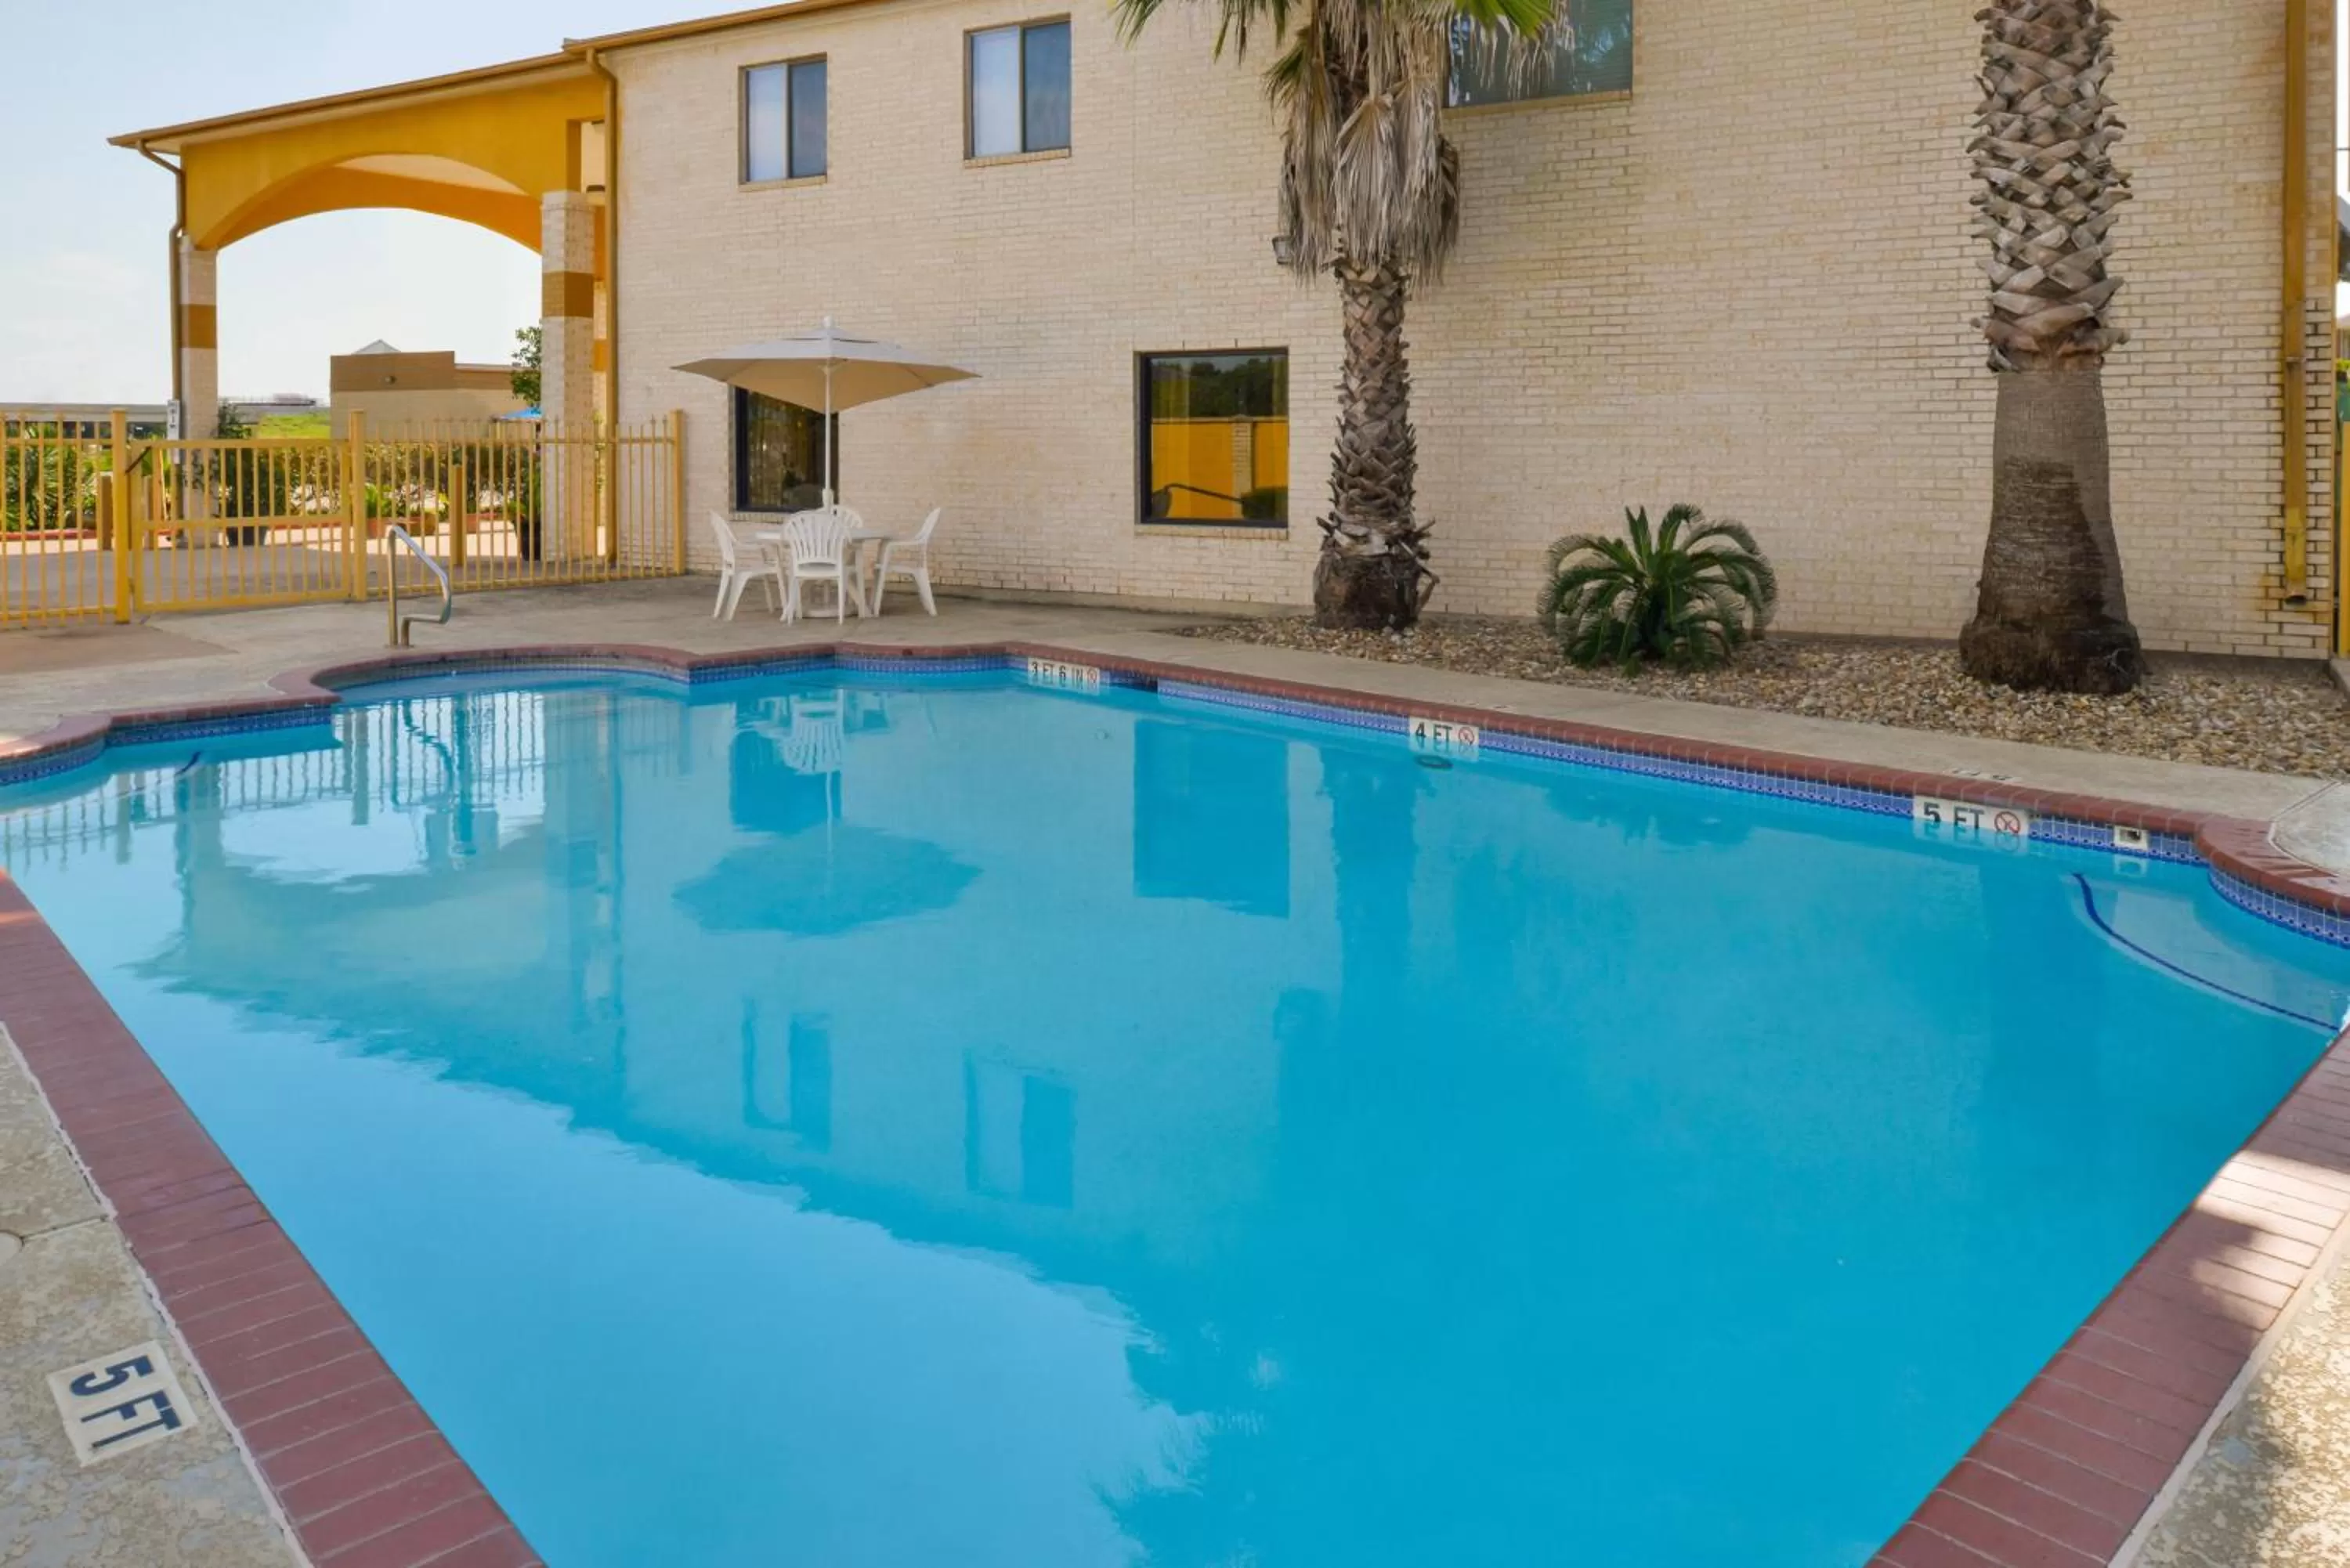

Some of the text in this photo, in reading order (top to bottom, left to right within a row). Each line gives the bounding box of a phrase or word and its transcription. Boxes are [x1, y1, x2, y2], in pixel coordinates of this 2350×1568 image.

[1415, 722, 1452, 742] 4 FT
[1924, 802, 1984, 829] 5 FT
[70, 1355, 182, 1448] 5 FT
